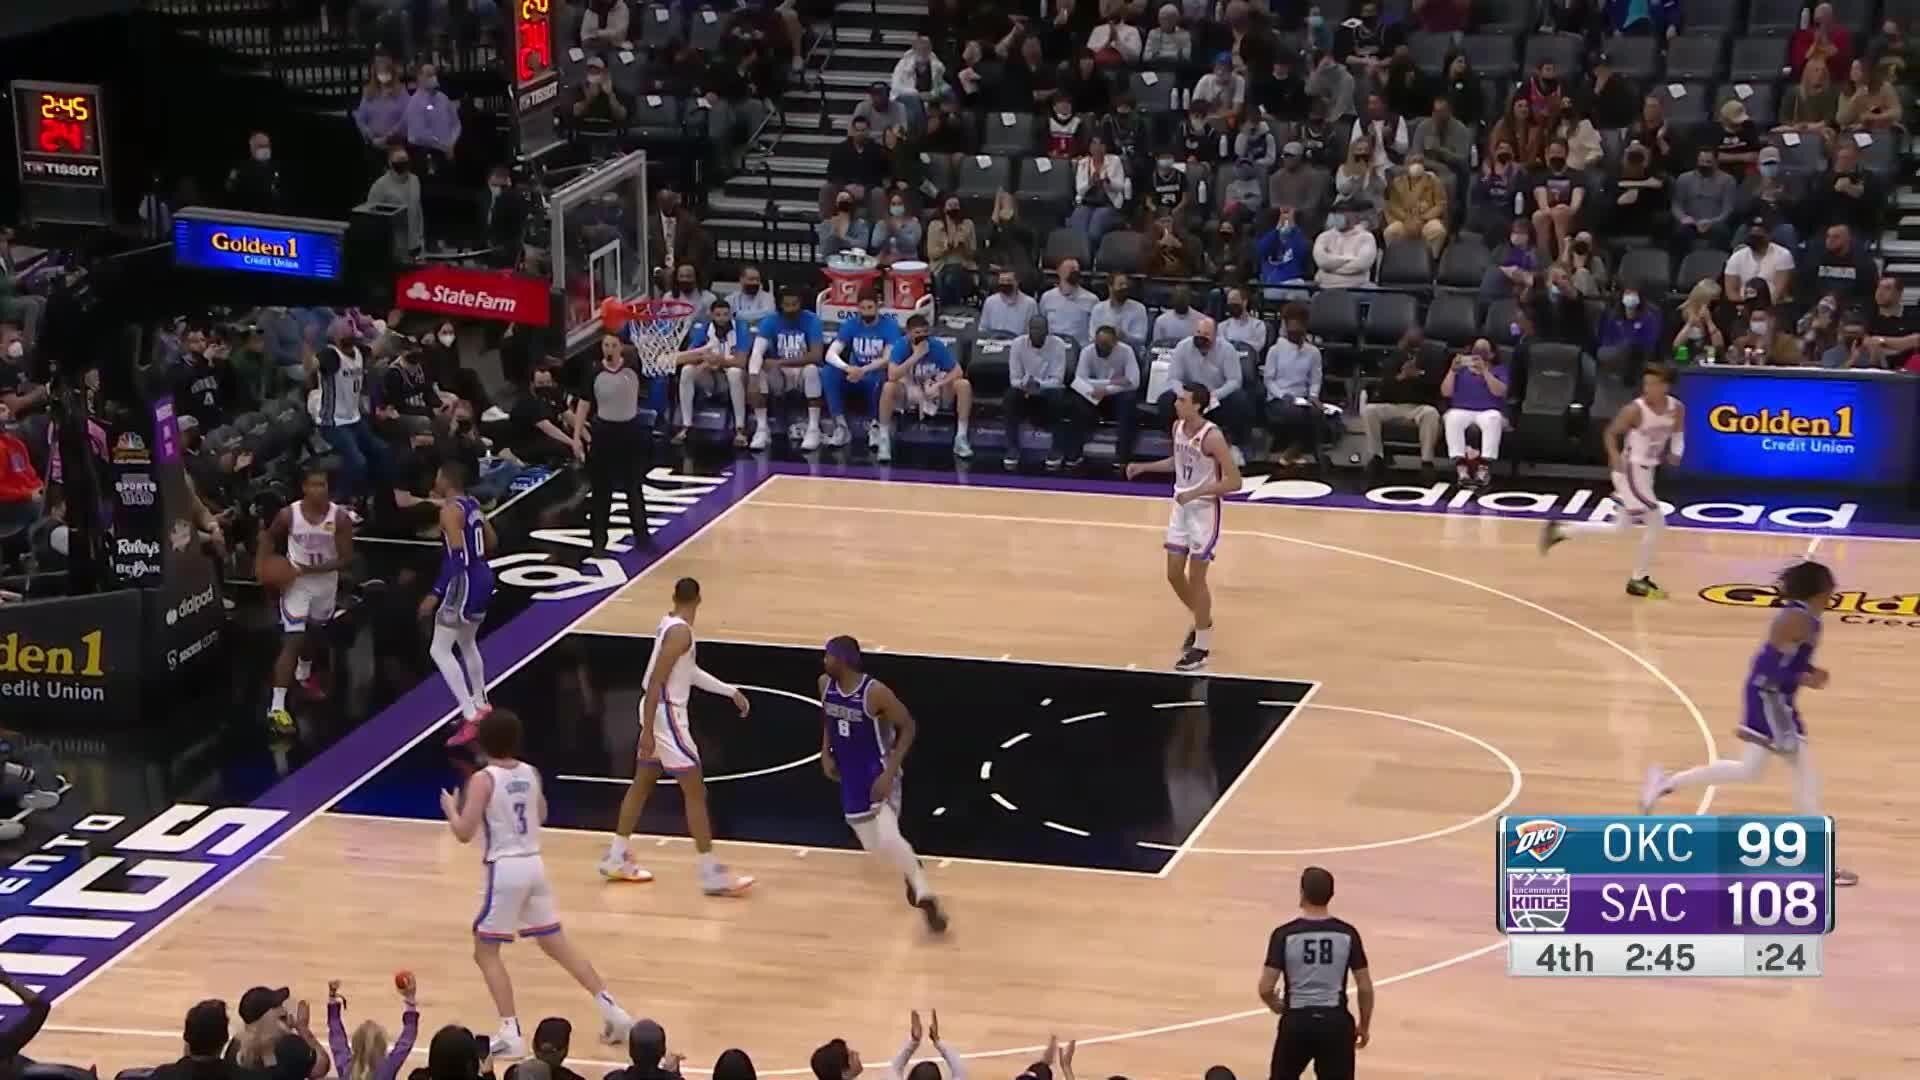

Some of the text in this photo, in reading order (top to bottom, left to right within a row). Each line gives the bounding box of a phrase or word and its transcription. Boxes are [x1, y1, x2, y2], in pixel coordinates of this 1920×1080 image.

[41, 94, 88, 120] 2:45
[41, 119, 82, 150] 24
[45, 163, 98, 176] TISSOT
[211, 232, 285, 257] Golden
[244, 255, 299, 269] Credit Union
[1709, 404, 1831, 437] Golden
[1835, 405, 1855, 438] 1
[1762, 438, 1855, 455] Credit Union
[115, 481, 157, 493] SPORTS
[474, 526, 485, 557] 0
[1699, 583, 1920, 617] Gld
[80, 629, 105, 677] 1
[47, 680, 105, 701] Union
[513, 802, 528, 835] 3
[1303, 938, 1333, 966] 58
